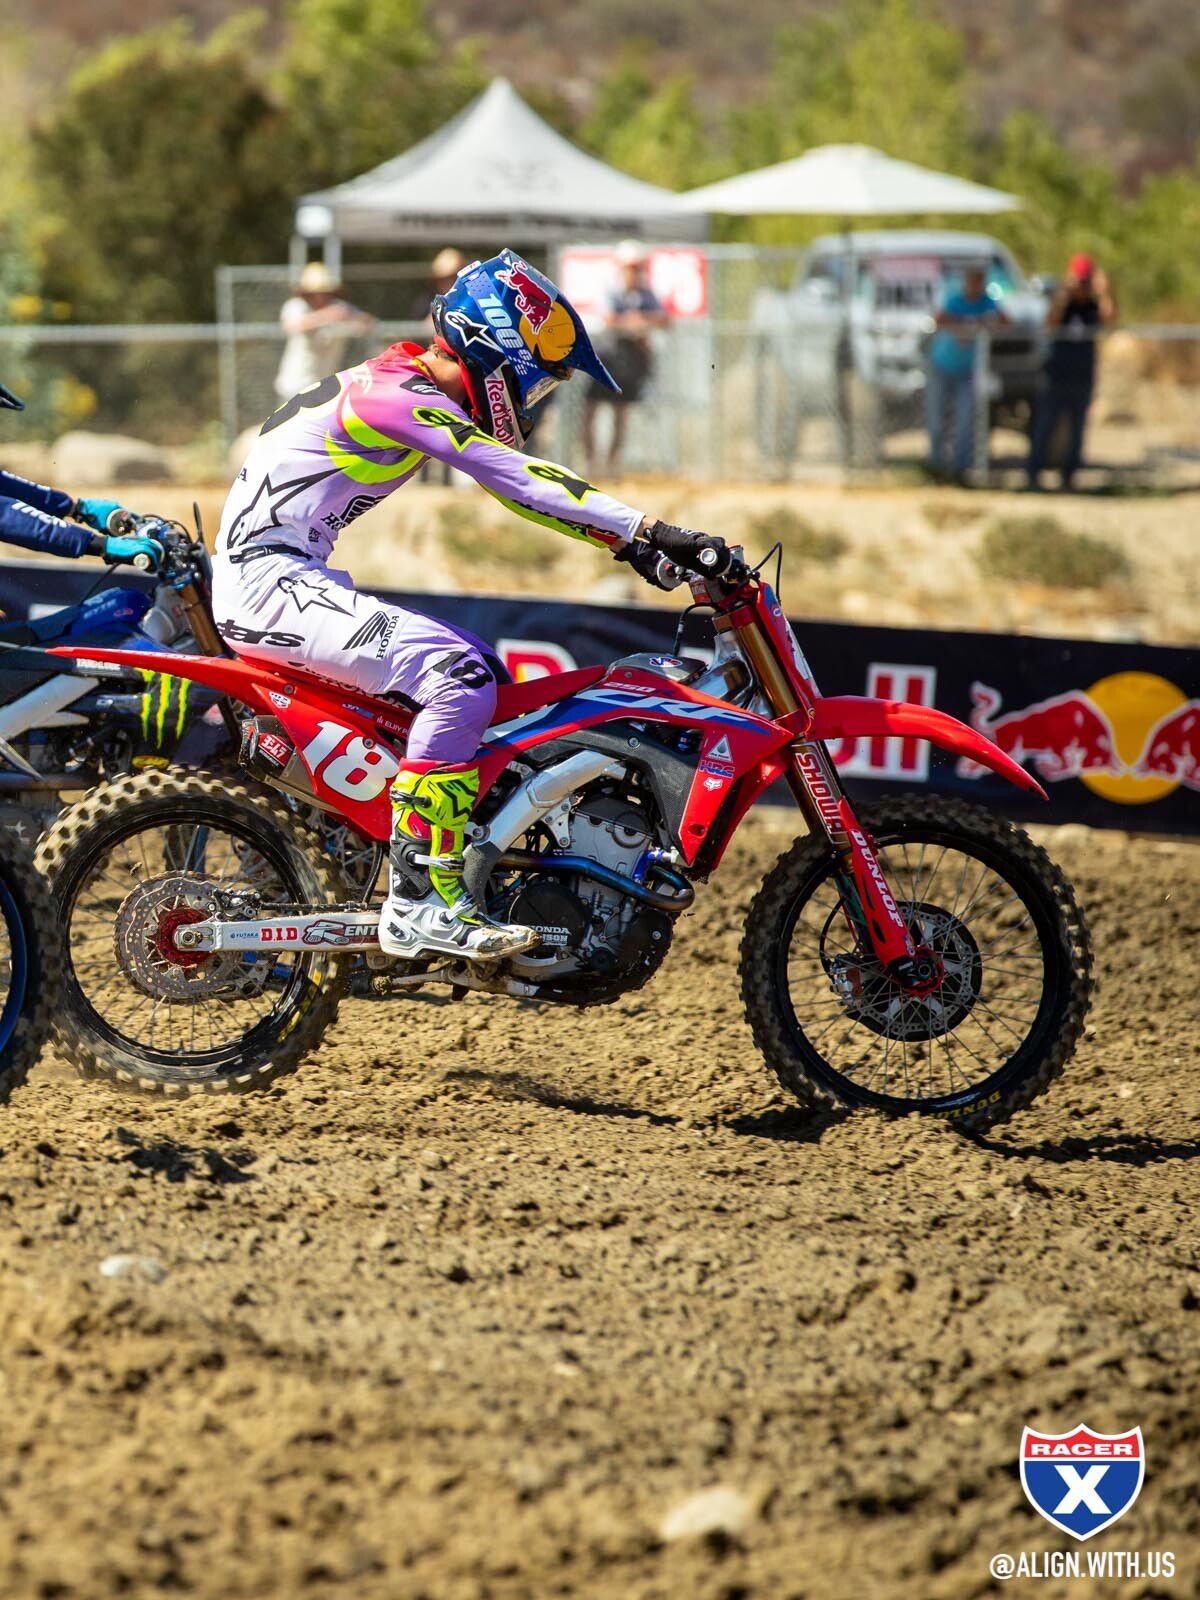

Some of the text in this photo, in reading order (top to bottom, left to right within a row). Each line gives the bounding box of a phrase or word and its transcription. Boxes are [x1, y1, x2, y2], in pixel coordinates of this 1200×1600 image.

[376, 615, 400, 660] HONDA
[302, 720, 400, 802] 18
[795, 752, 848, 836] SHOWA
[851, 829, 904, 928] DUNLOP
[261, 927, 298, 942] D.I.D
